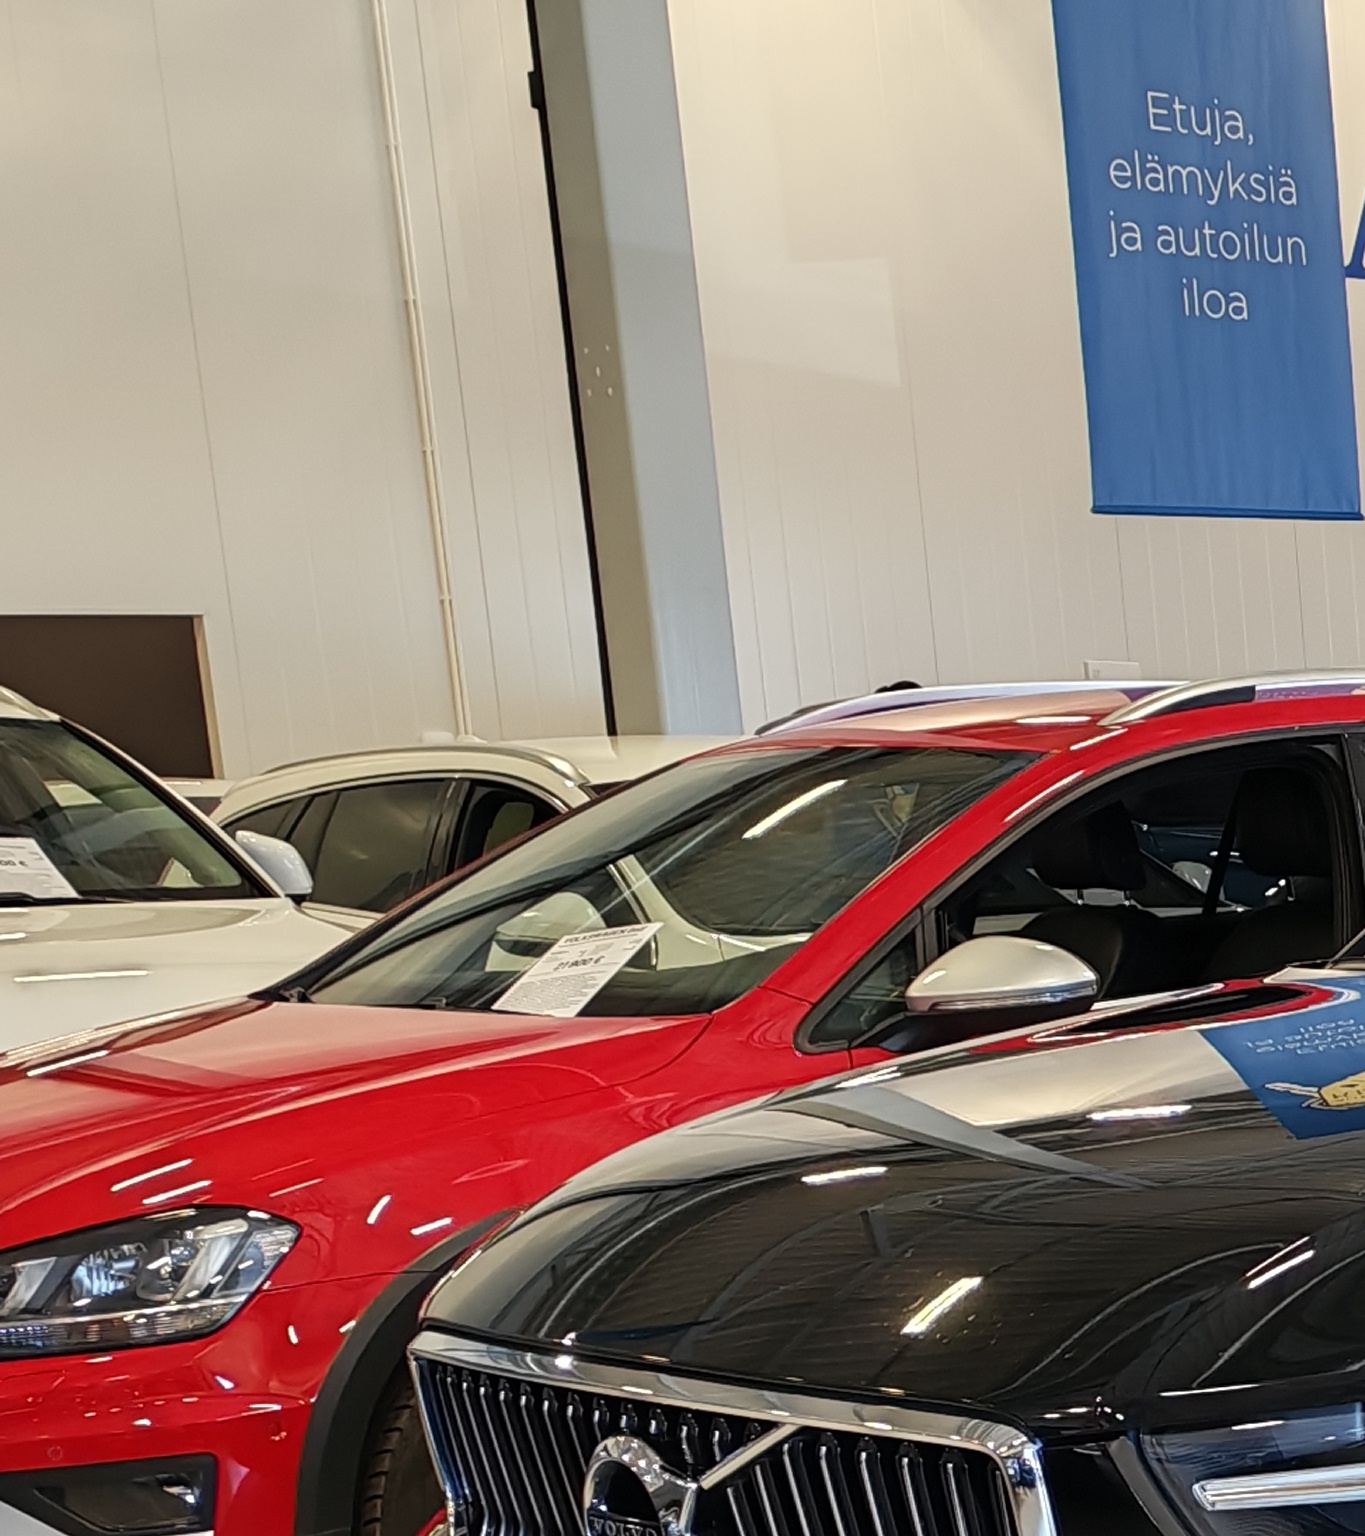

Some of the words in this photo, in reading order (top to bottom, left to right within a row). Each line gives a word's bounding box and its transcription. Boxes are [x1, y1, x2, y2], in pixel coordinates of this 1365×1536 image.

[1147, 91, 1254, 145] Etuja,
[1109, 149, 1297, 206] elämyksiä
[1109, 209, 1142, 258] ja
[1156, 220, 1307, 266] autoilun
[1182, 277, 1248, 320] iloa
